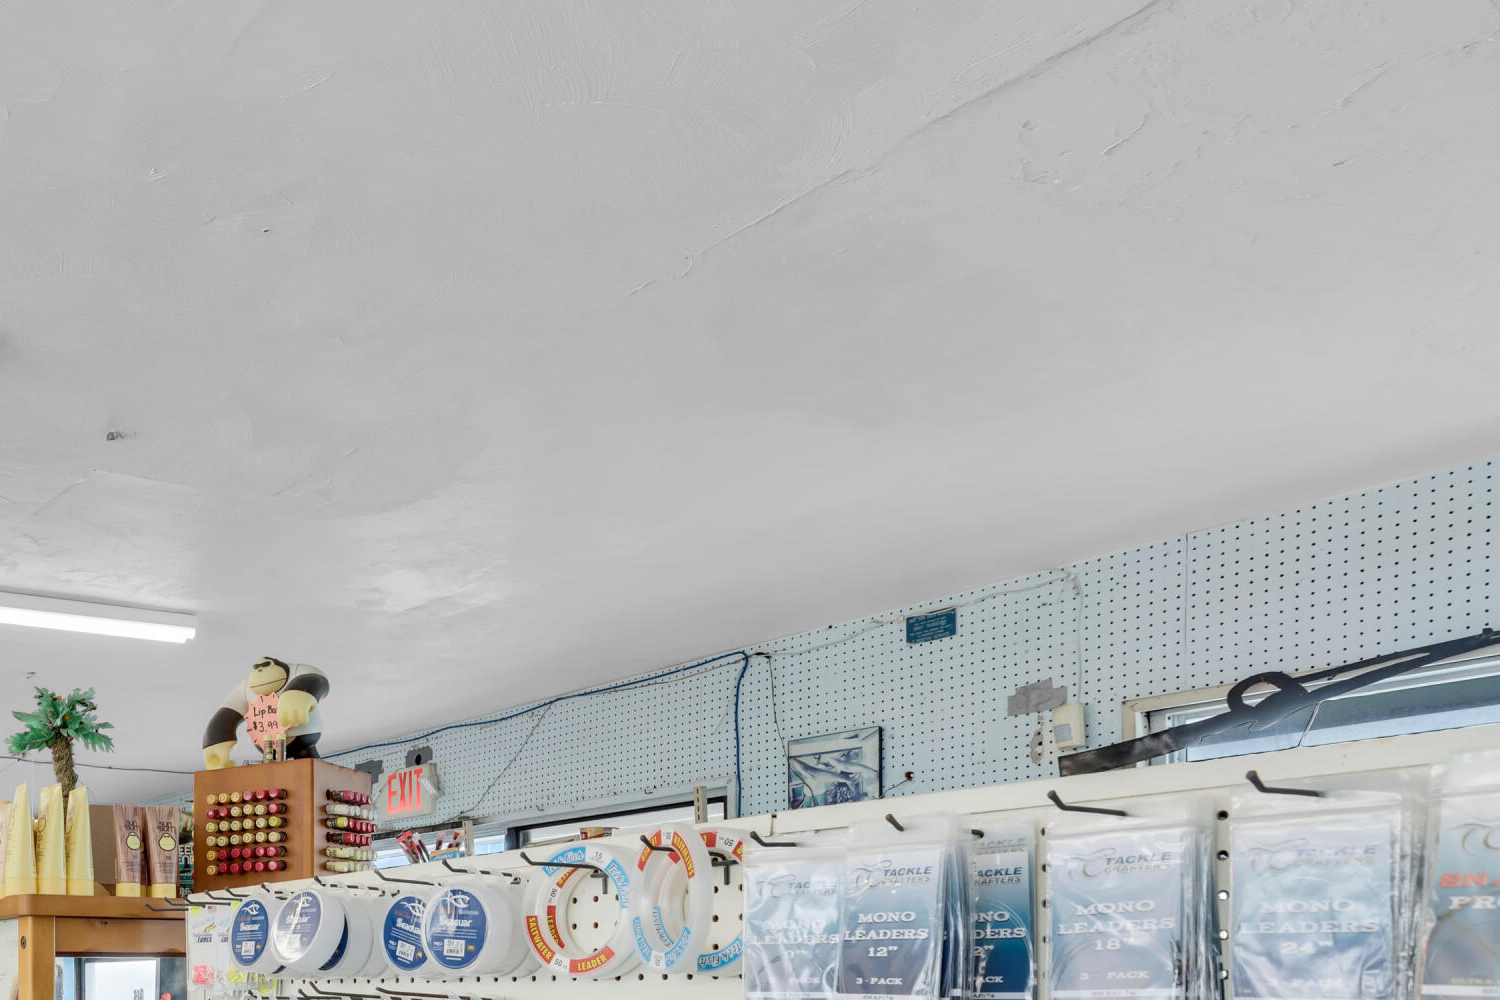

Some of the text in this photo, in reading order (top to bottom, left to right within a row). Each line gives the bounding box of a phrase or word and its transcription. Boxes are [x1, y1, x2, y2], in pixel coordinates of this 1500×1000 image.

[253, 705, 266, 719] Lip
[252, 720, 278, 733] $3.99
[387, 767, 424, 815] EXIT
[1105, 851, 1173, 866] TACKLE
[884, 866, 933, 876] TACKLE
[1074, 900, 1156, 916] MONO
[1260, 900, 1355, 914] MONO
[857, 911, 917, 924] MONO
[1058, 917, 1175, 936] LEADERS
[1238, 919, 1381, 935] LEADERS
[528, 916, 552, 961] SALTWATER
[843, 928, 930, 941] LEADERS
[867, 945, 899, 958] 12"
[577, 955, 607, 972] LEADER
[1107, 971, 1150, 980] PACK
